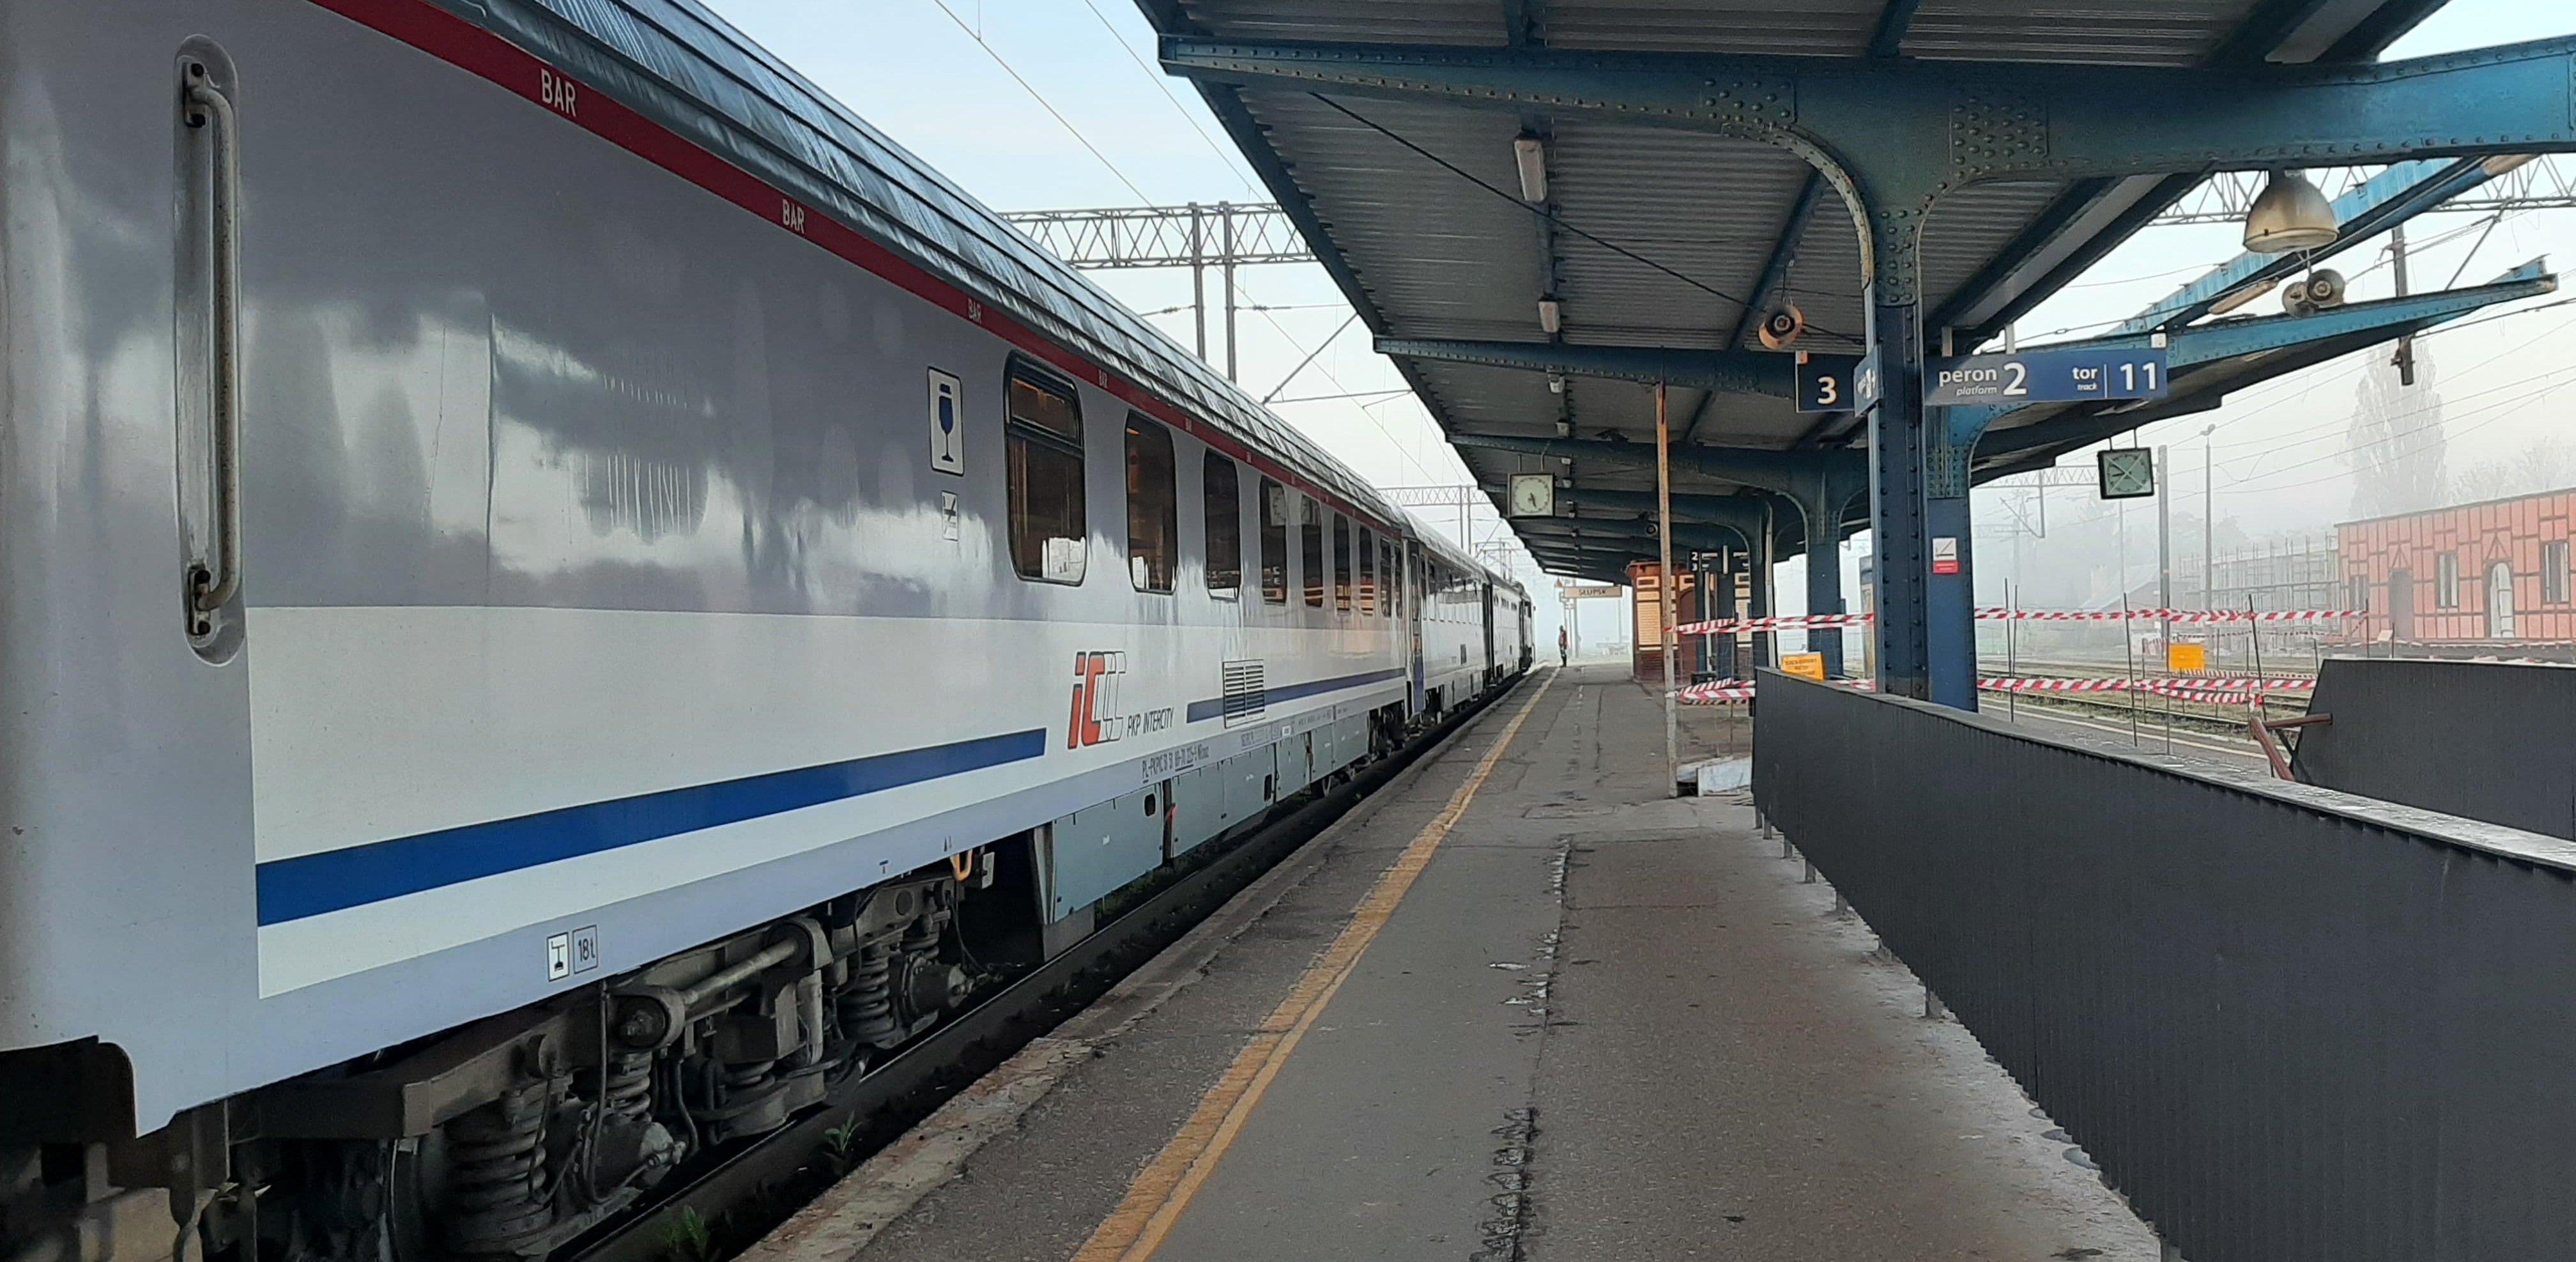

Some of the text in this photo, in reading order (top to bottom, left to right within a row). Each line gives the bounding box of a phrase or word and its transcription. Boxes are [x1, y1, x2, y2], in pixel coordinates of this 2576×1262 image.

[540, 68, 576, 117] BAR
[782, 199, 804, 234] BAR
[968, 298, 982, 325] BAR
[1939, 362, 2027, 396] peron 2
[2072, 362, 2156, 390] tor 11
[2077, 382, 2097, 391] track
[1818, 376, 1837, 405] 3
[1956, 385, 1997, 397] platform
[1691, 552, 1699, 561] 2
[1127, 706, 1174, 738] PKP INTERCITY
[578, 935, 595, 962] 18t
